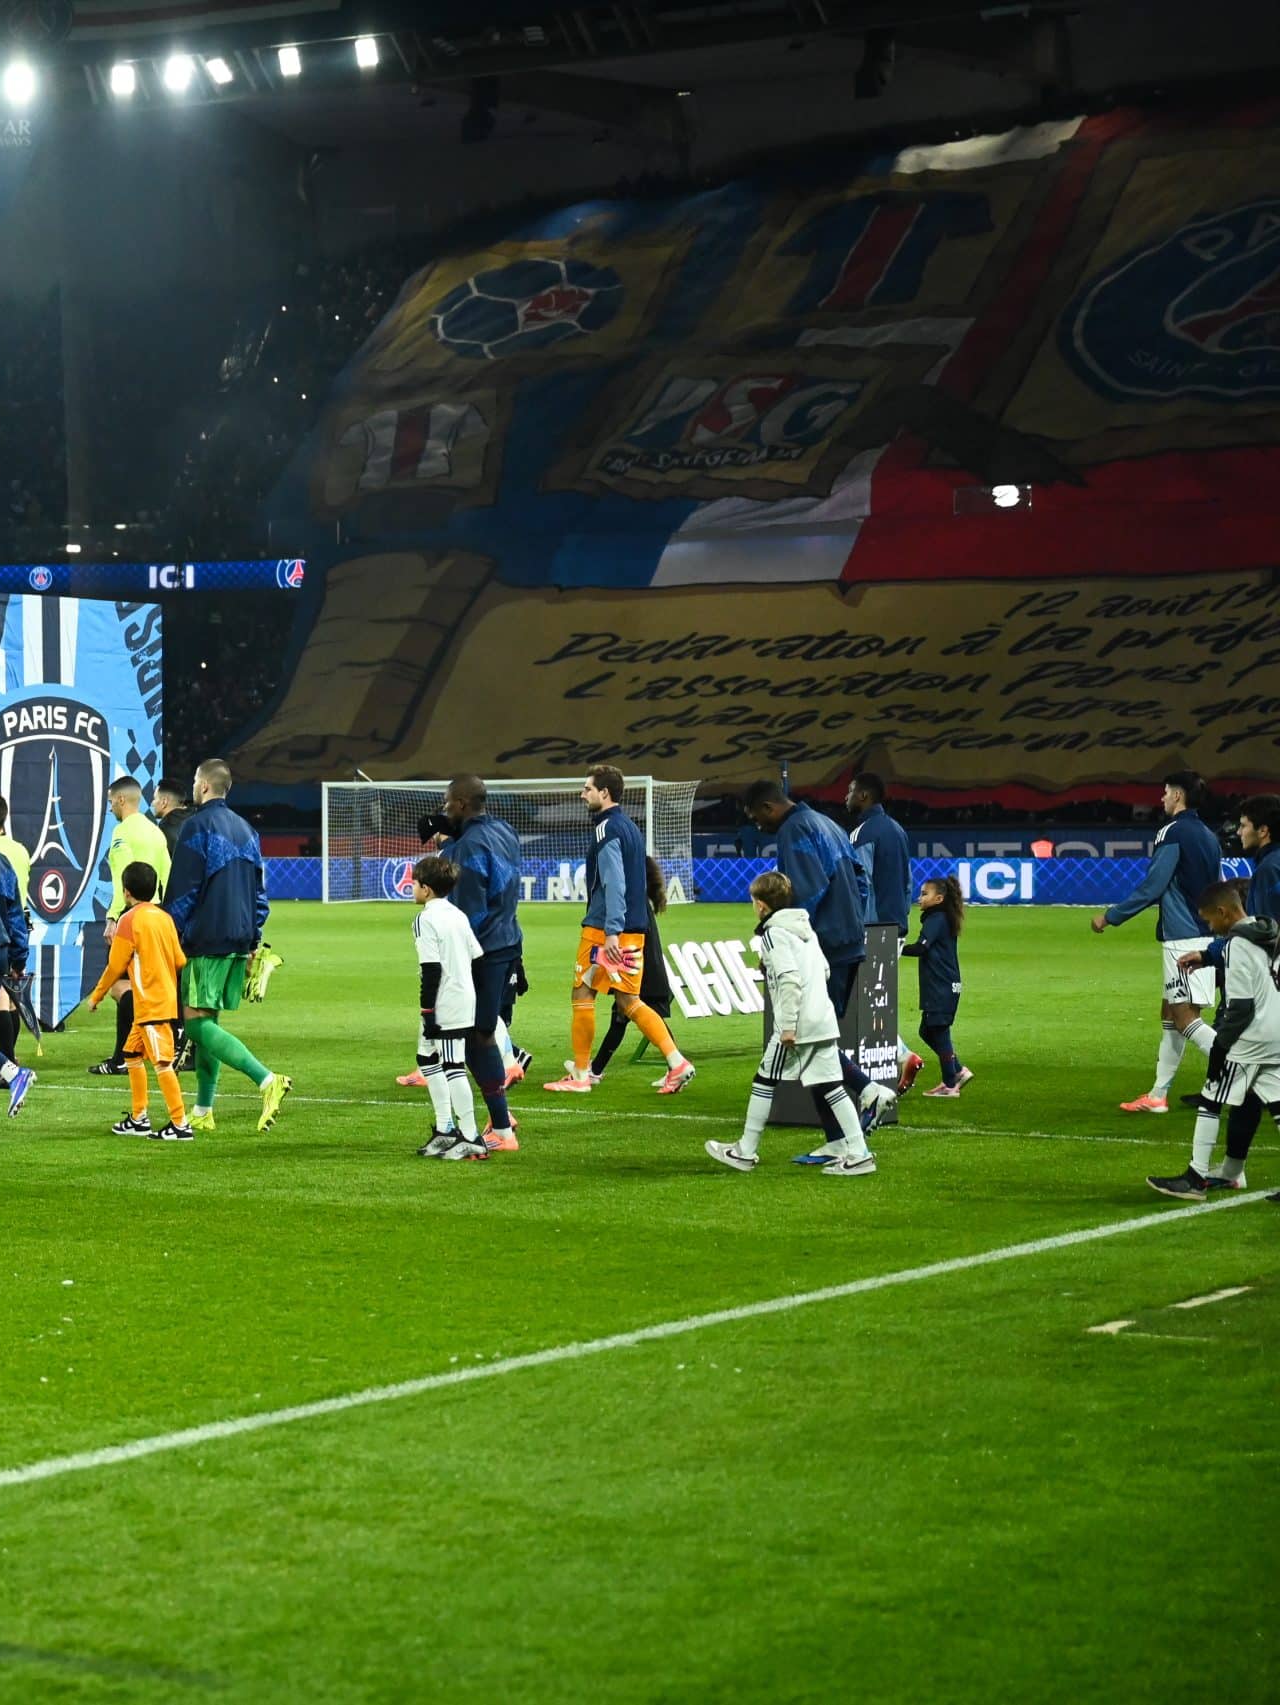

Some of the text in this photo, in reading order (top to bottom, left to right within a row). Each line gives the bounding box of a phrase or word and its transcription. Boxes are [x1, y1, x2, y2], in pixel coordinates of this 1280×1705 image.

[148, 565, 196, 589] ICI
[4, 705, 103, 742] PARIS FC
[958, 862, 1033, 899] ICI
[859, 1037, 897, 1067] Équipier
[871, 1062, 898, 1081] match
